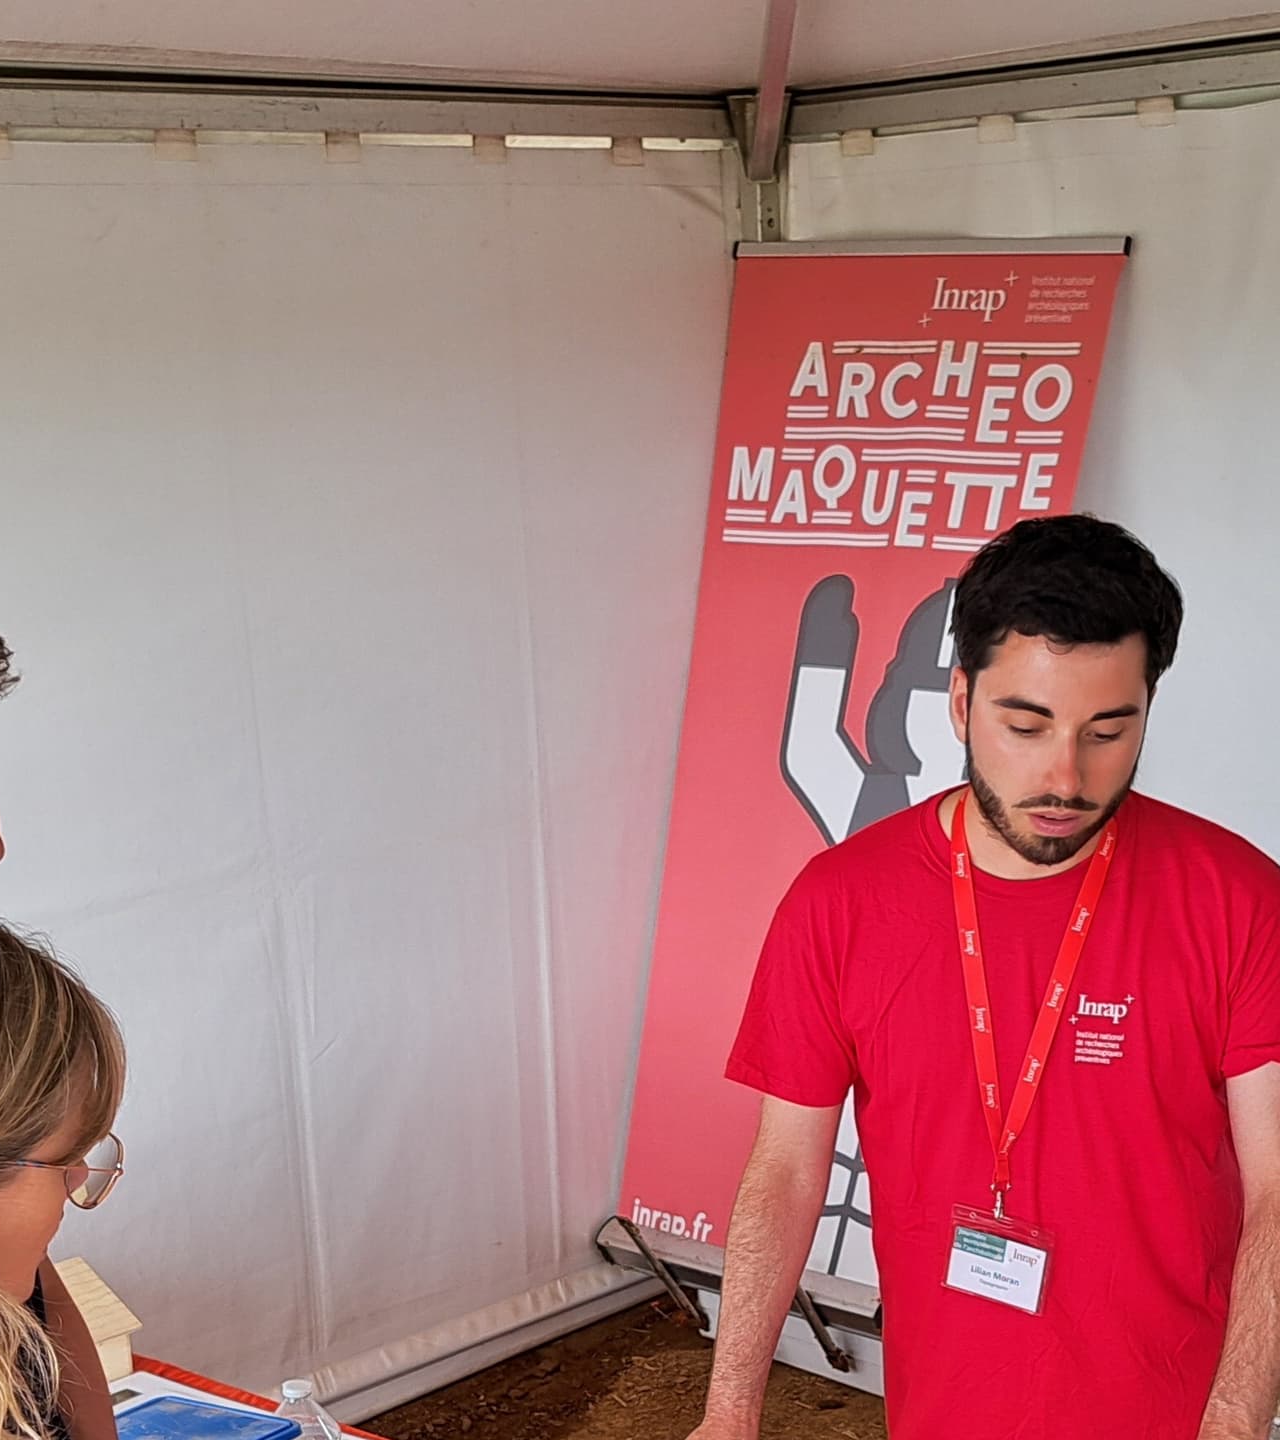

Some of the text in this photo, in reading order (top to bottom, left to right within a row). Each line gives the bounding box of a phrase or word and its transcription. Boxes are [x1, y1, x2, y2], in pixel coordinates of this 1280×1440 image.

[930, 276, 1007, 322] Inrap
[727, 444, 1059, 547] MAQUETTE
[1077, 994, 1128, 1024] Inrap
[632, 1197, 713, 1243] inrap.fr
